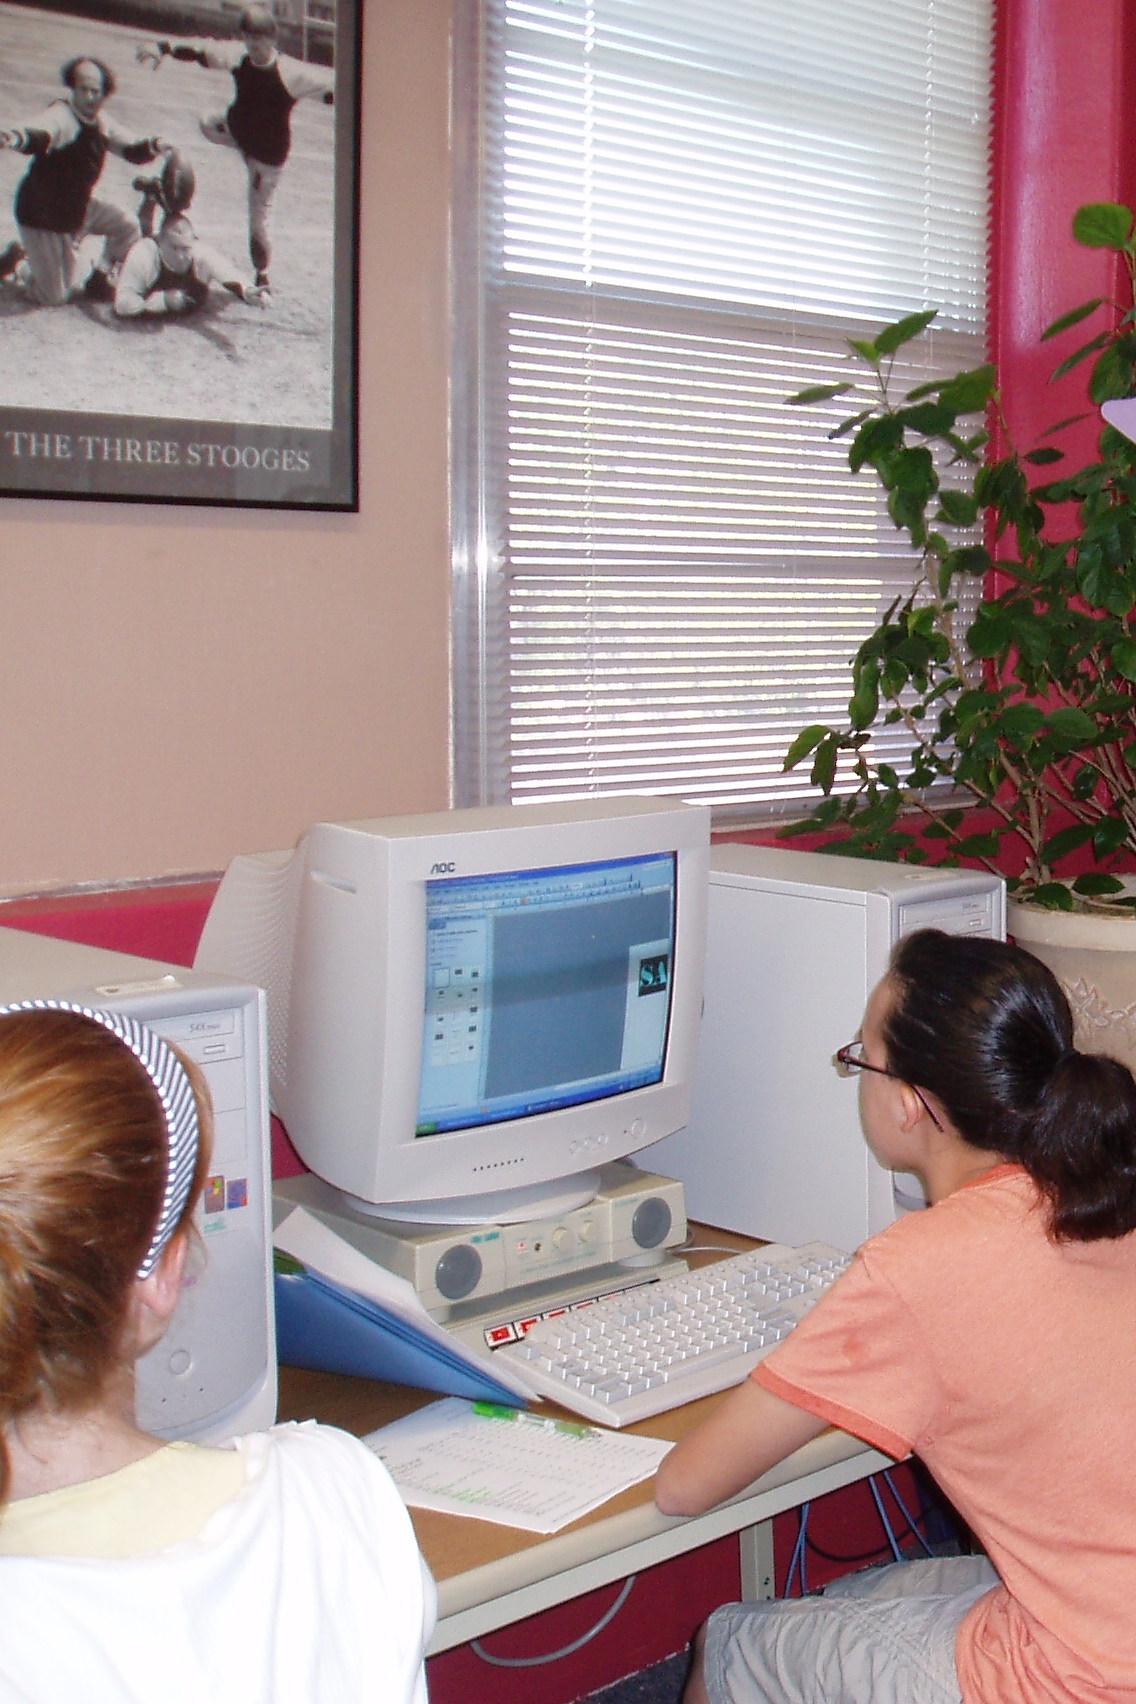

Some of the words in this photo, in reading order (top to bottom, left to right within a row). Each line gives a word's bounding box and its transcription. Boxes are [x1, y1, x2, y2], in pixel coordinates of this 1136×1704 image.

[5, 431, 71, 459] THE
[79, 435, 181, 465] THREE
[187, 442, 311, 472] STOOGES
[430, 862, 456, 875] AOC
